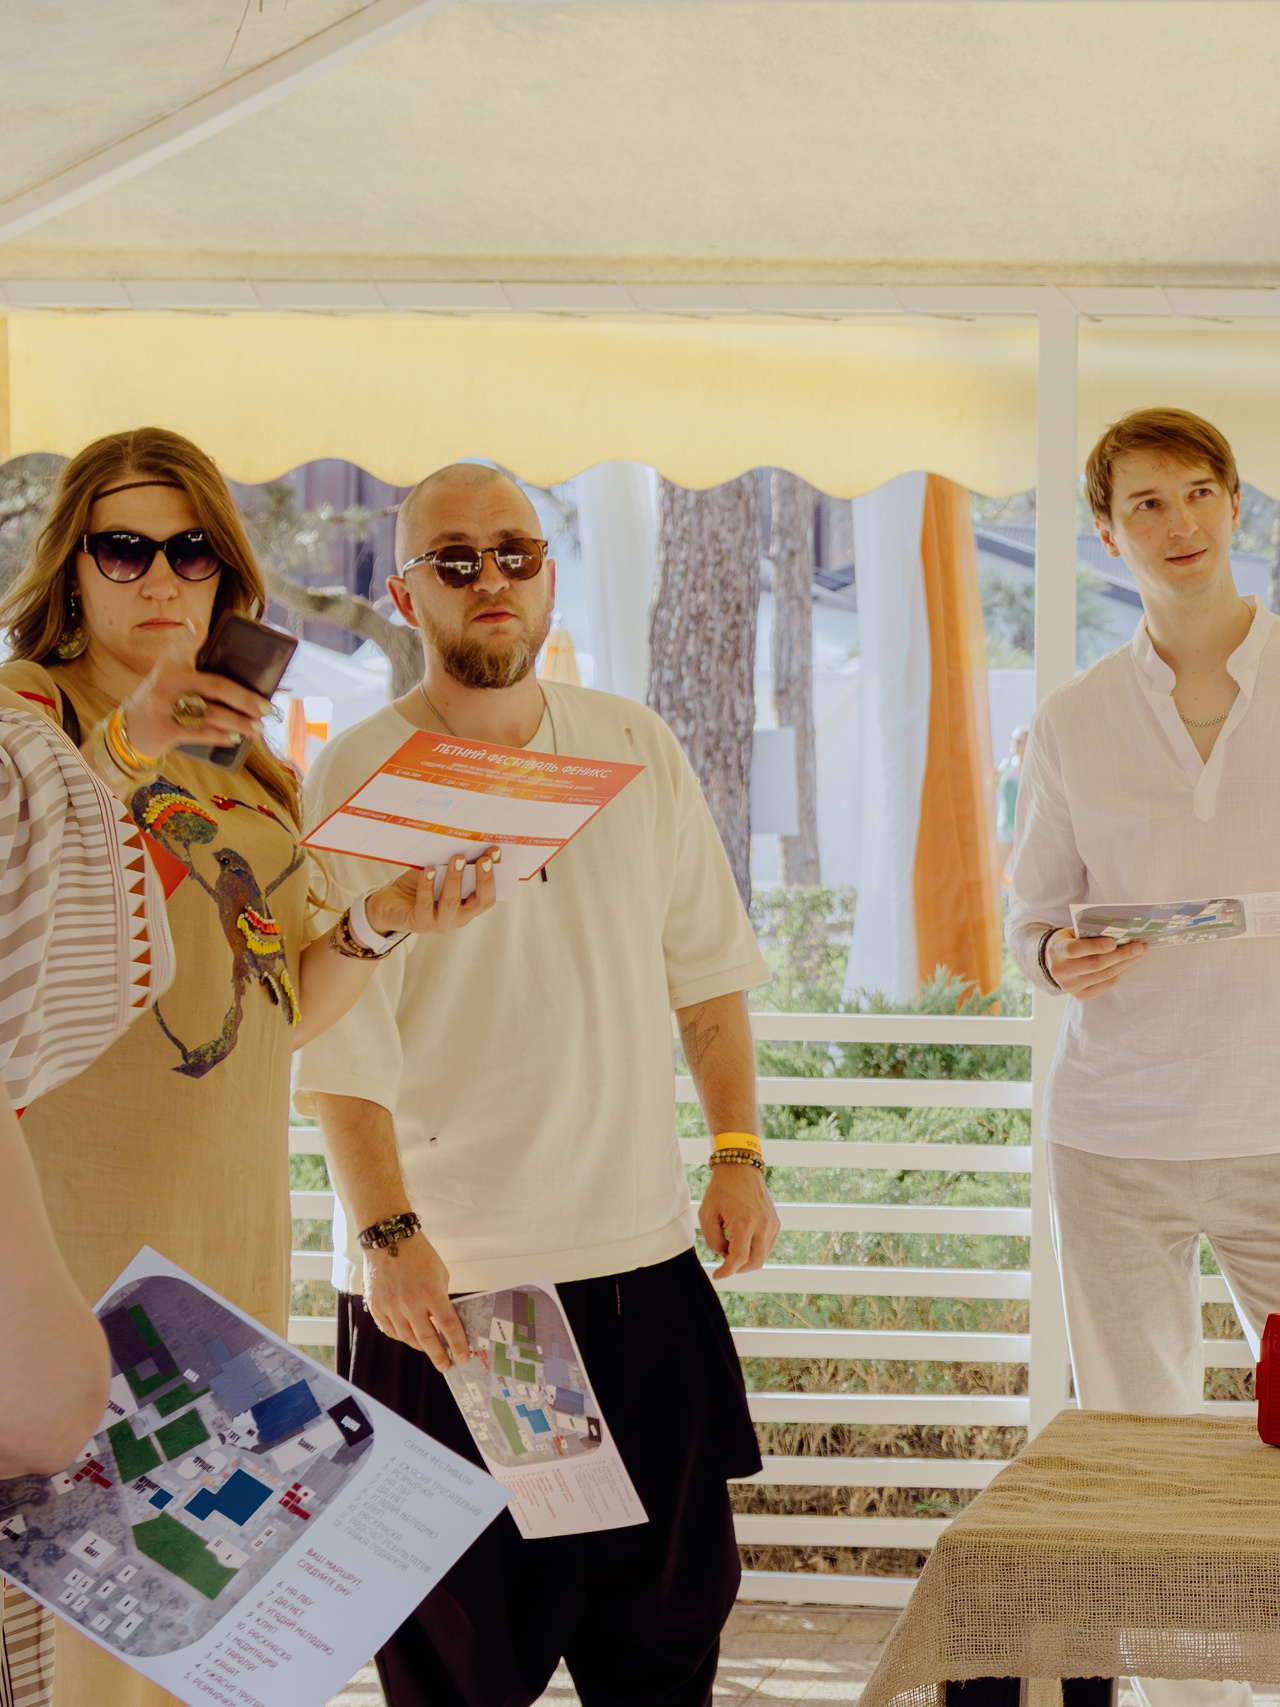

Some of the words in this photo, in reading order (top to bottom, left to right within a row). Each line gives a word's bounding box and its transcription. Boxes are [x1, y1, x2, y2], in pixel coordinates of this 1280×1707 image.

[432, 743, 487, 761] ЛЕТНИЙ
[487, 754, 560, 773] ФЕСТИВАЛЬ
[561, 765, 613, 779] ФЕНИКС
[403, 1439, 430, 1458] СХЕМА
[192, 1457, 216, 1475] фуршет
[376, 1485, 407, 1506] ДА/НЕТ
[383, 1477, 397, 1488] НА
[396, 1485, 413, 1498] ЛБУ
[391, 1470, 435, 1499] РЕЗИНОЧКИ
[398, 1461, 432, 1485] УЖАСНО
[430, 1482, 483, 1517] ТРОГАТЕЛЬНО
[362, 1501, 385, 1518] КЛИП
[357, 1511, 404, 1542] РАСКРАСКА
[398, 1512, 440, 1540] МЕЛОДИЮ
[83, 1546, 100, 1558] канат
[343, 1527, 370, 1546] ЛАВКА
[368, 1543, 410, 1572] ПОДАРКОВ
[381, 1539, 432, 1573] РЕЗУЛЬТАТОВ
[296, 1559, 336, 1587] СЛЕДУЙТЕ
[306, 1549, 326, 1564] ВАШ
[323, 1561, 364, 1589] МАРШРУТ,
[274, 1596, 305, 1618] ДА/НЕТ
[276, 1580, 286, 1588] 6.
[284, 1586, 299, 1597] НА
[297, 1594, 315, 1607] ЛБУ
[254, 1618, 278, 1635] КЛИП
[265, 1607, 297, 1630] УГАДАЙ
[294, 1627, 337, 1656] МЕЛОДИЮ
[231, 1637, 279, 1669] МЕДИТАЦИЯ
[236, 1622, 248, 1631] 10.
[247, 1630, 294, 1661] РАСКРАСКА
[204, 1652, 214, 1660] 3.
[213, 1658, 240, 1677] КАНАТ
[224, 1649, 259, 1673] ТАРОЛОГ
[183, 1672, 193, 1681] 5.
[203, 1669, 237, 1693] УЖАСНО
